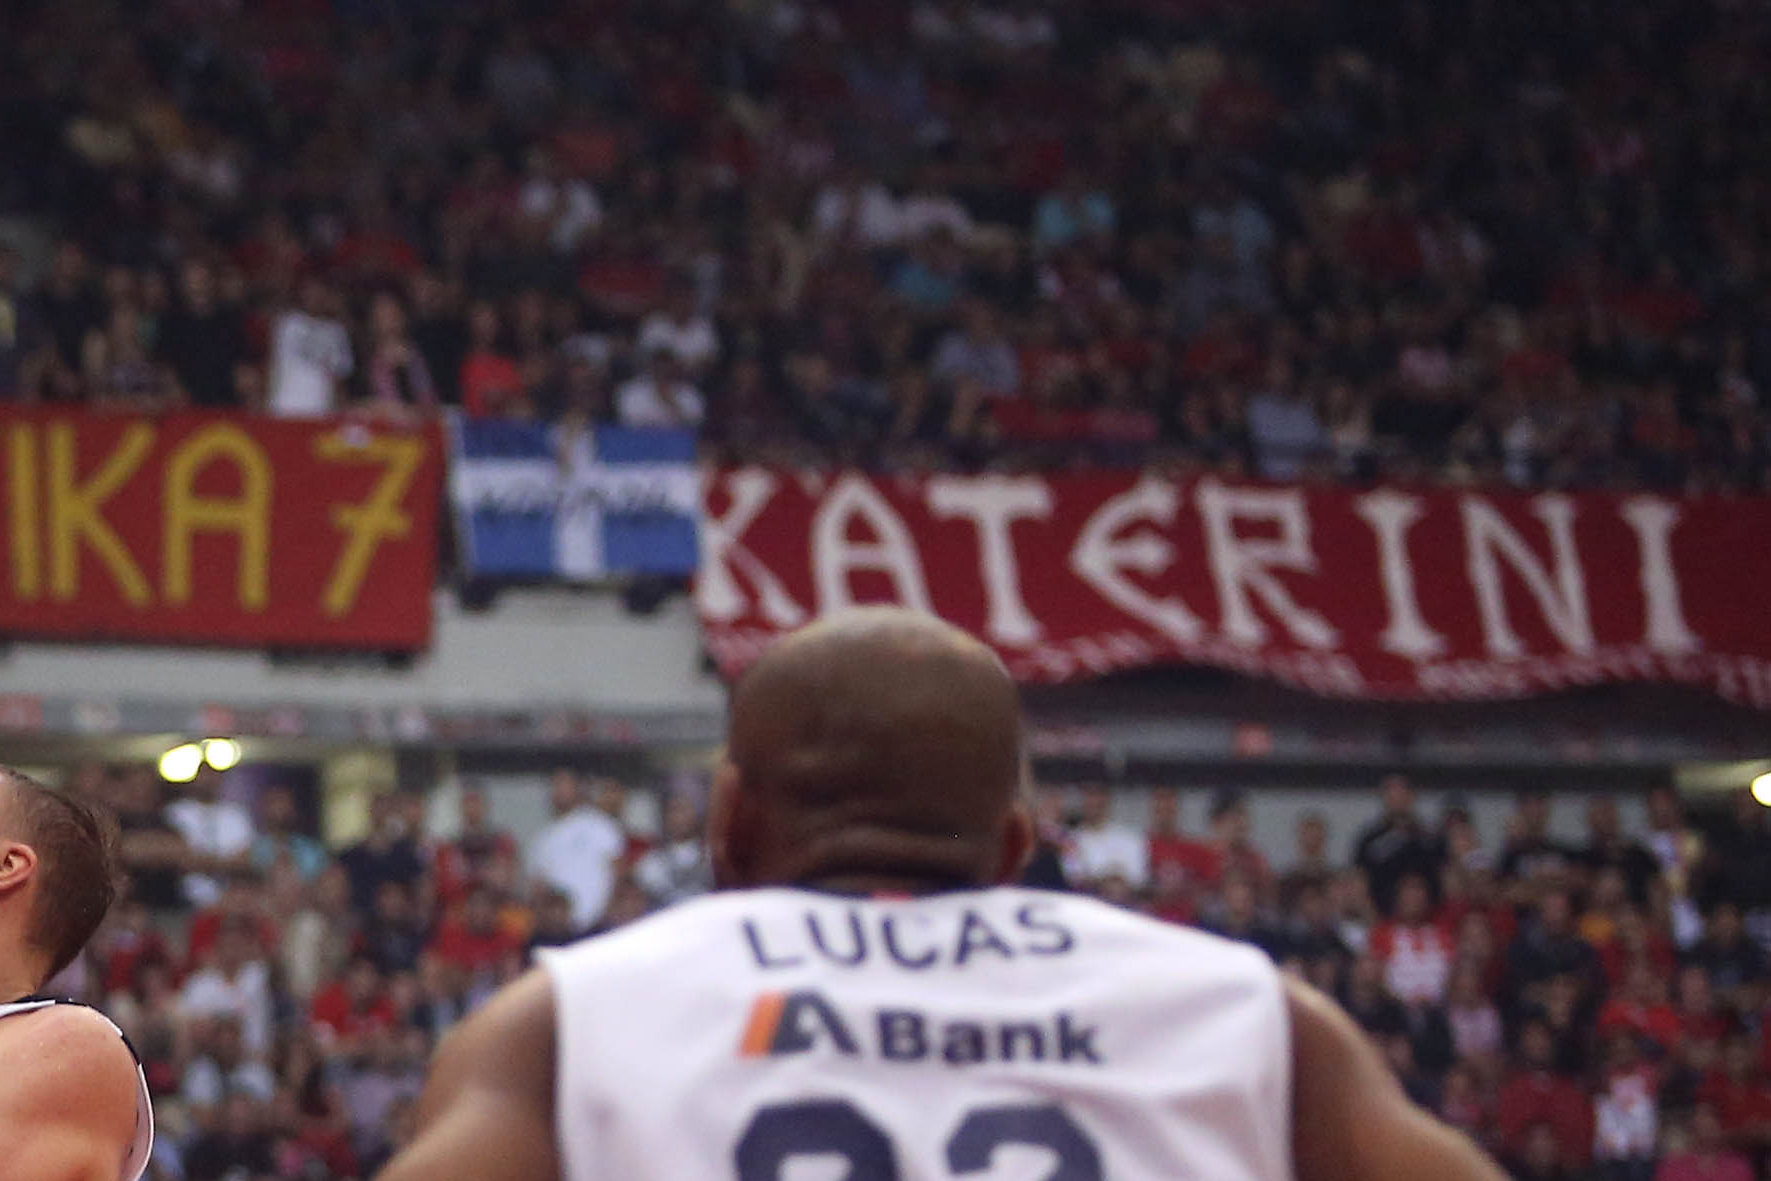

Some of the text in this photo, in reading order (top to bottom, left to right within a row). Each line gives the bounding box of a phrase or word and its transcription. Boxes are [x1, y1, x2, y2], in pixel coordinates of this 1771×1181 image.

[311, 431, 426, 614] 7
[696, 464, 1701, 657] KATERINI
[741, 900, 1076, 970] LUCAS
